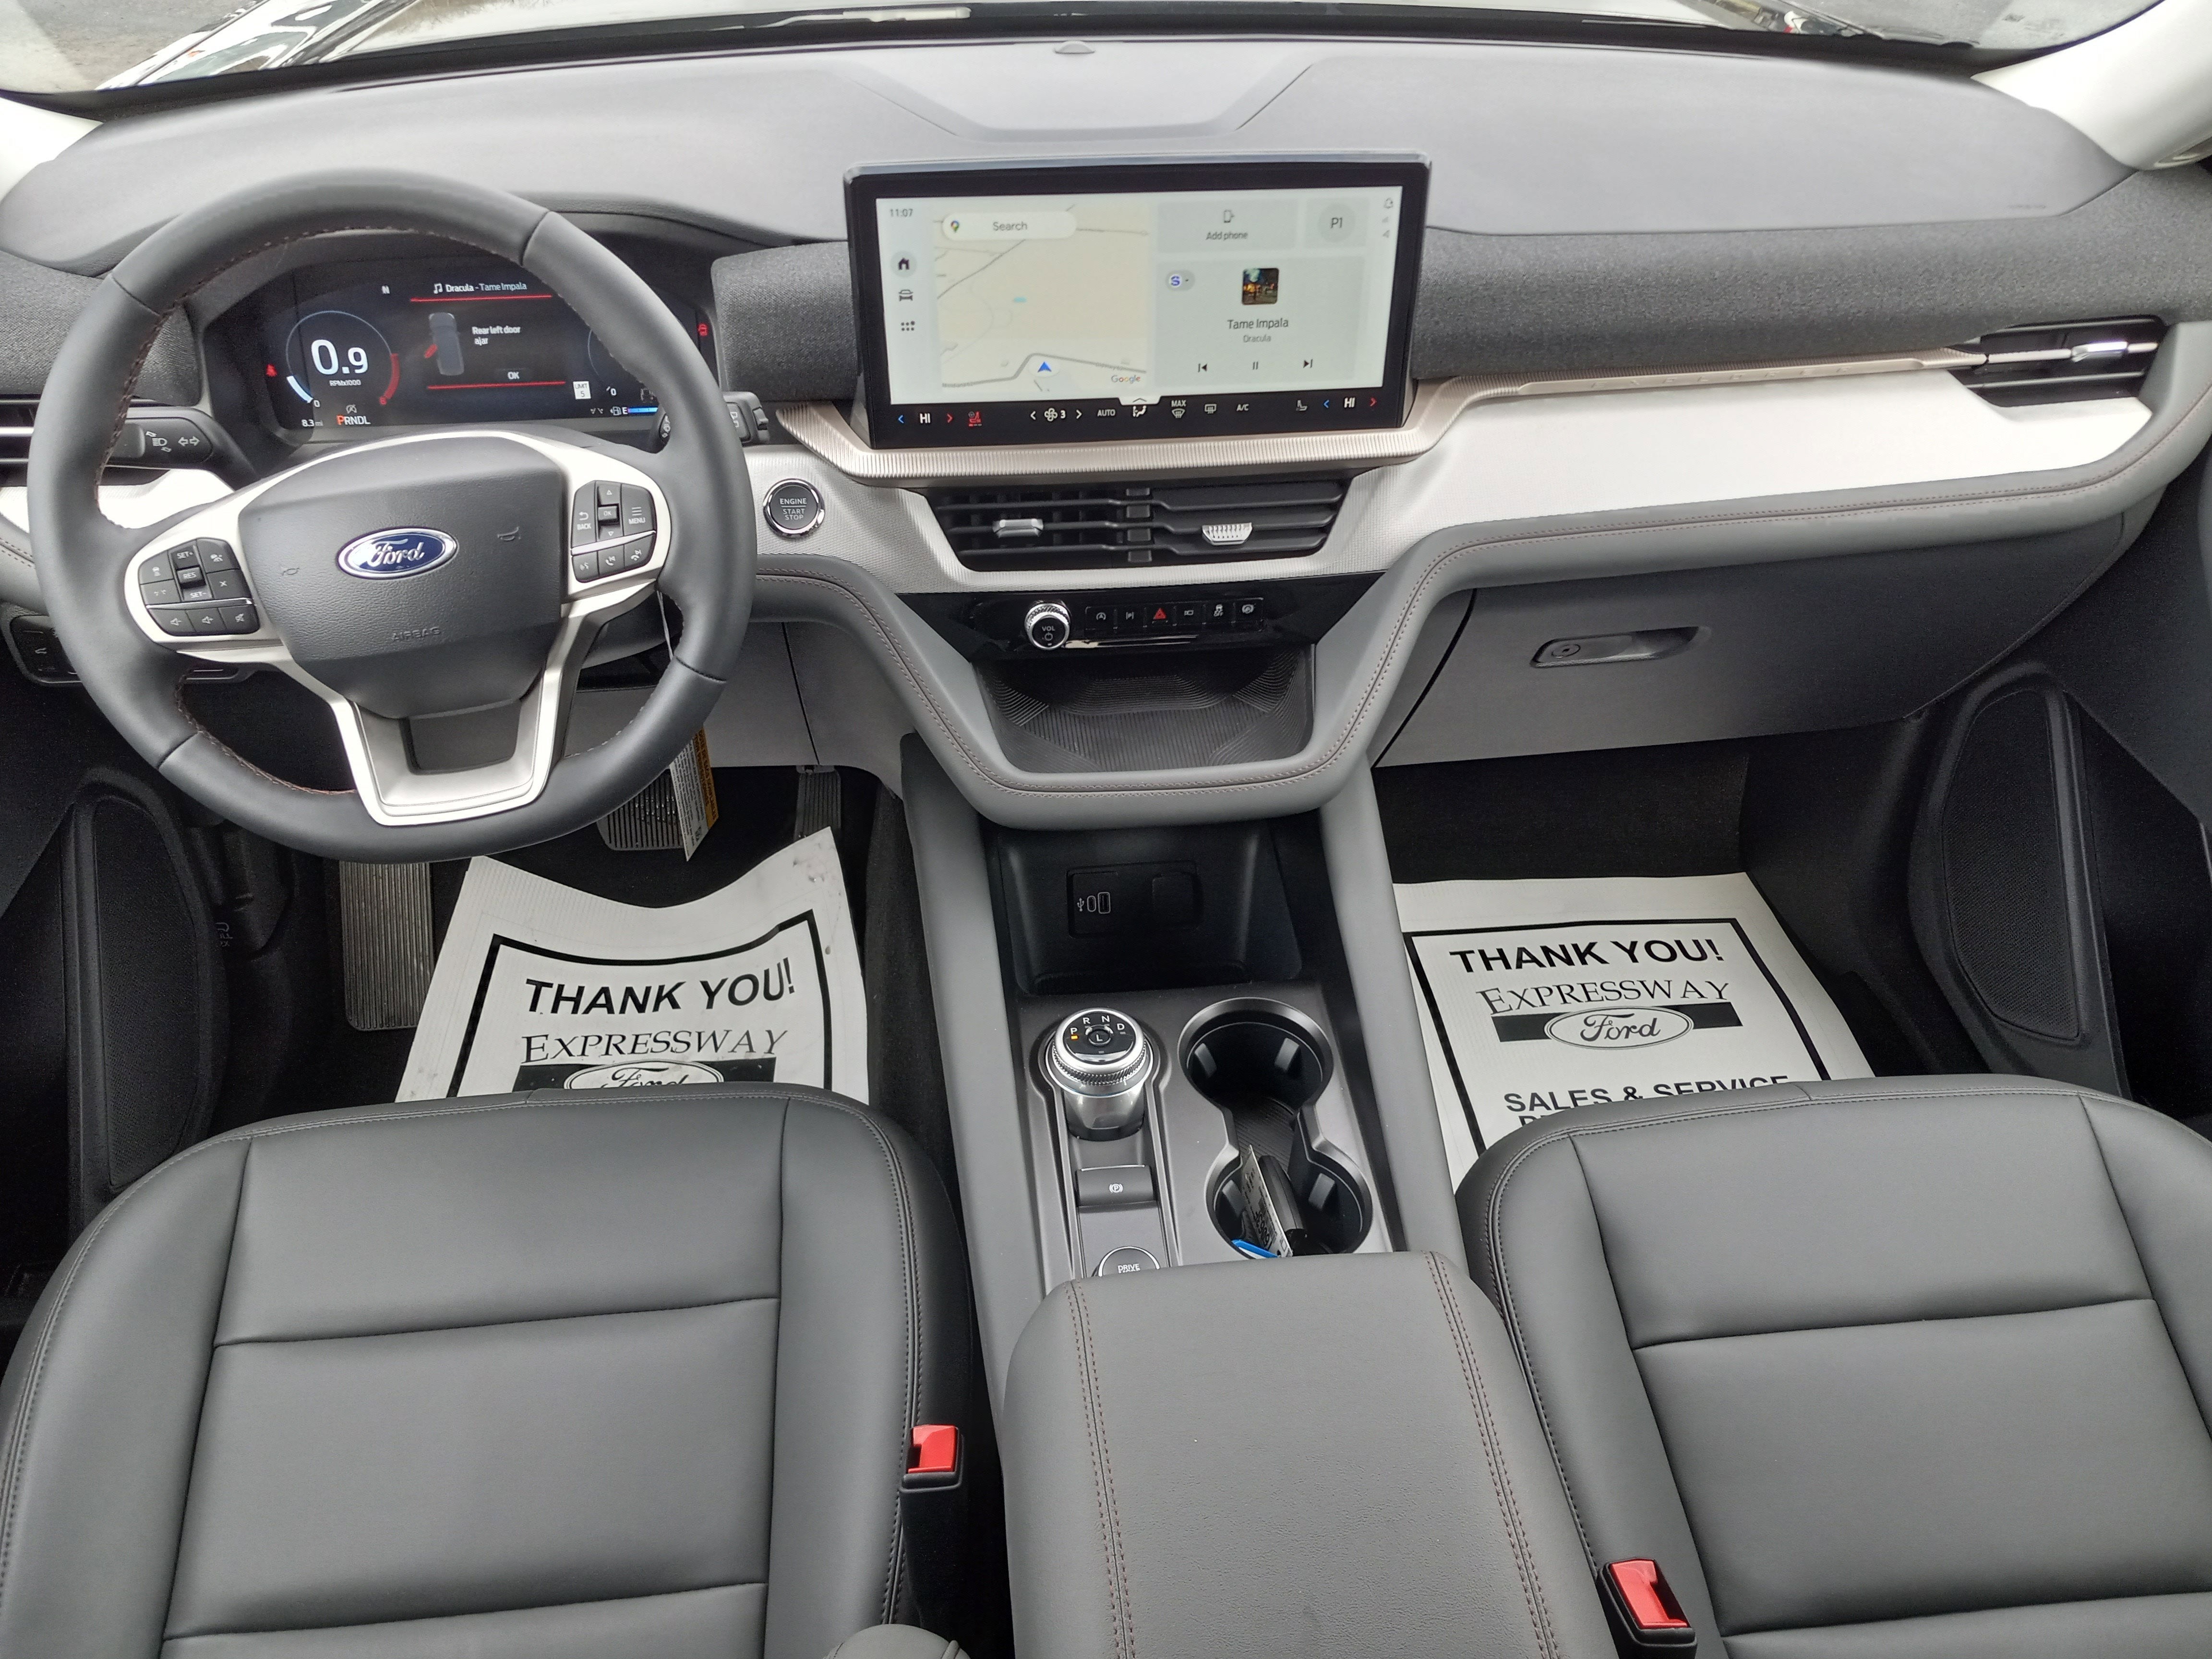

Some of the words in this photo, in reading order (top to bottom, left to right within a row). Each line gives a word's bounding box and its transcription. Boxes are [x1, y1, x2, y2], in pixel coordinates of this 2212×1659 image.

[890, 208, 914, 217] 11:07
[993, 221, 1028, 231] Search
[1330, 216, 1343, 229] P1
[1206, 232, 1222, 240] Add
[1224, 231, 1248, 241] phone
[445, 284, 474, 292] Dracula
[479, 283, 501, 291] Tame
[501, 282, 528, 292] Impala
[1227, 319, 1254, 329] Tame
[1256, 317, 1289, 330] Impala
[472, 326, 489, 335] Rear
[490, 326, 503, 334] left
[504, 325, 521, 334] door
[474, 337, 488, 346] ajar
[1243, 334, 1271, 343] Dracula
[311, 339, 368, 375] 0.9
[507, 371, 519, 380] OK
[1111, 374, 1141, 384] Google
[1237, 403, 1249, 411] A/C
[1344, 397, 1355, 408] HI
[1060, 410, 1066, 419] 3
[1097, 409, 1116, 417] AUTO
[337, 415, 371, 425] PRNDL
[920, 413, 931, 424] HI
[367, 538, 424, 567] Ford
[1449, 941, 1610, 973] THANK
[1611, 938, 1724, 964] YOU!
[526, 978, 686, 1015] THANK
[699, 957, 795, 1010] YOU!
[1580, 1012, 1661, 1042] Ford
